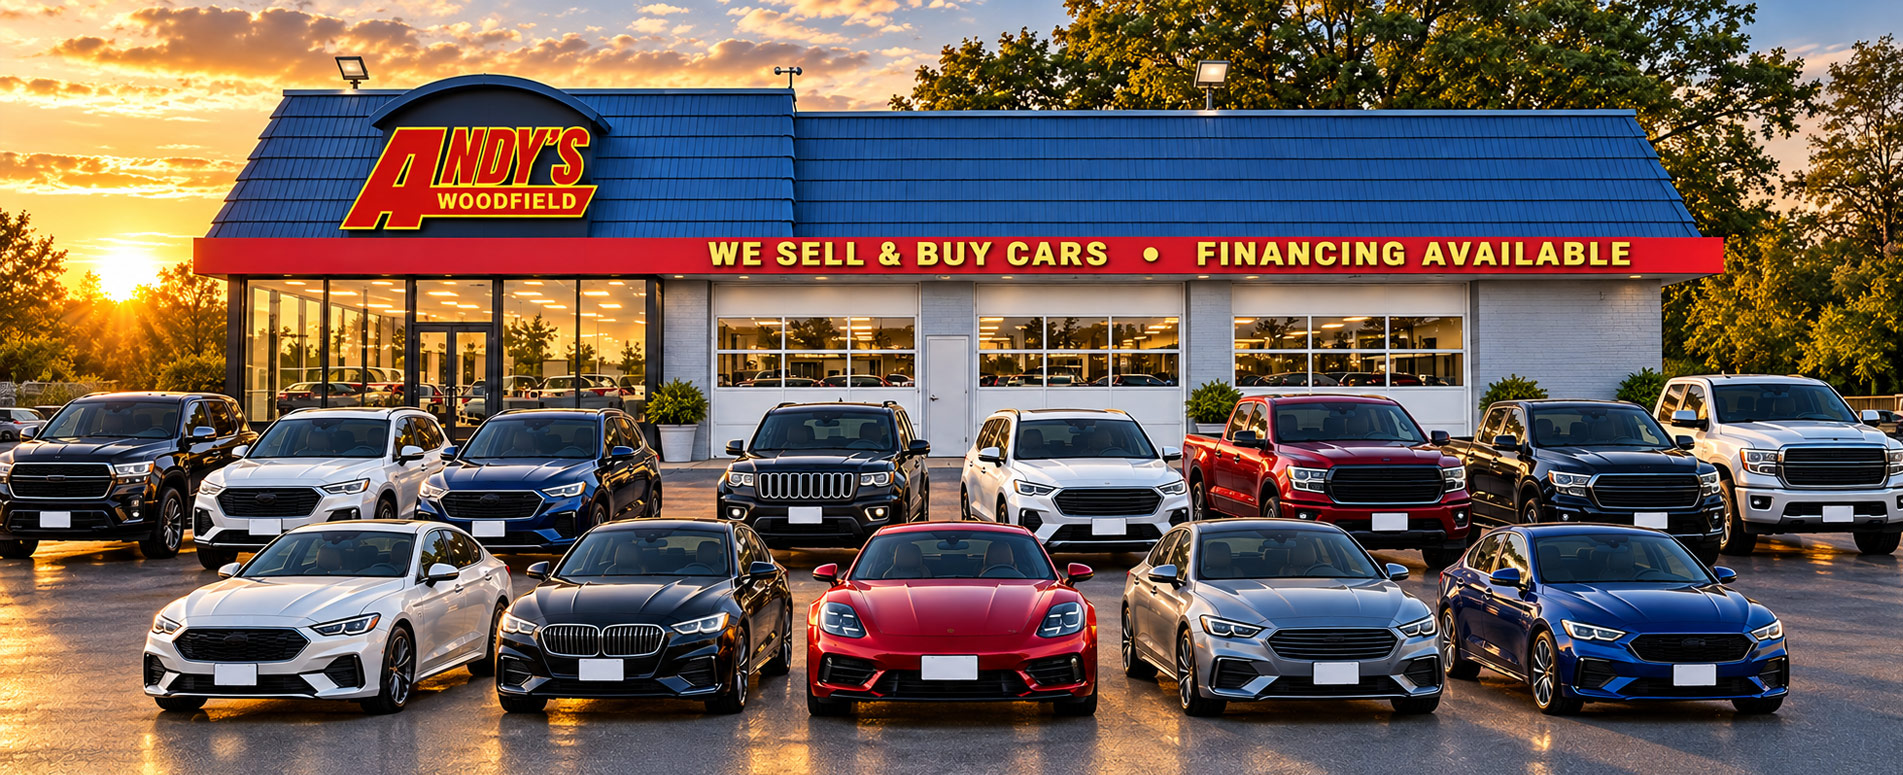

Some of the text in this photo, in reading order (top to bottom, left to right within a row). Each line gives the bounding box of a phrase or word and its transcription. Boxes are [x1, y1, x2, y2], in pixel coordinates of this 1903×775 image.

[339, 126, 591, 230] ANDY'S
[437, 192, 577, 210] WOODFIELD
[708, 241, 1109, 266] WE SELL & BUY CARS
[1197, 241, 1631, 266] FINANCING AVAILABLE
